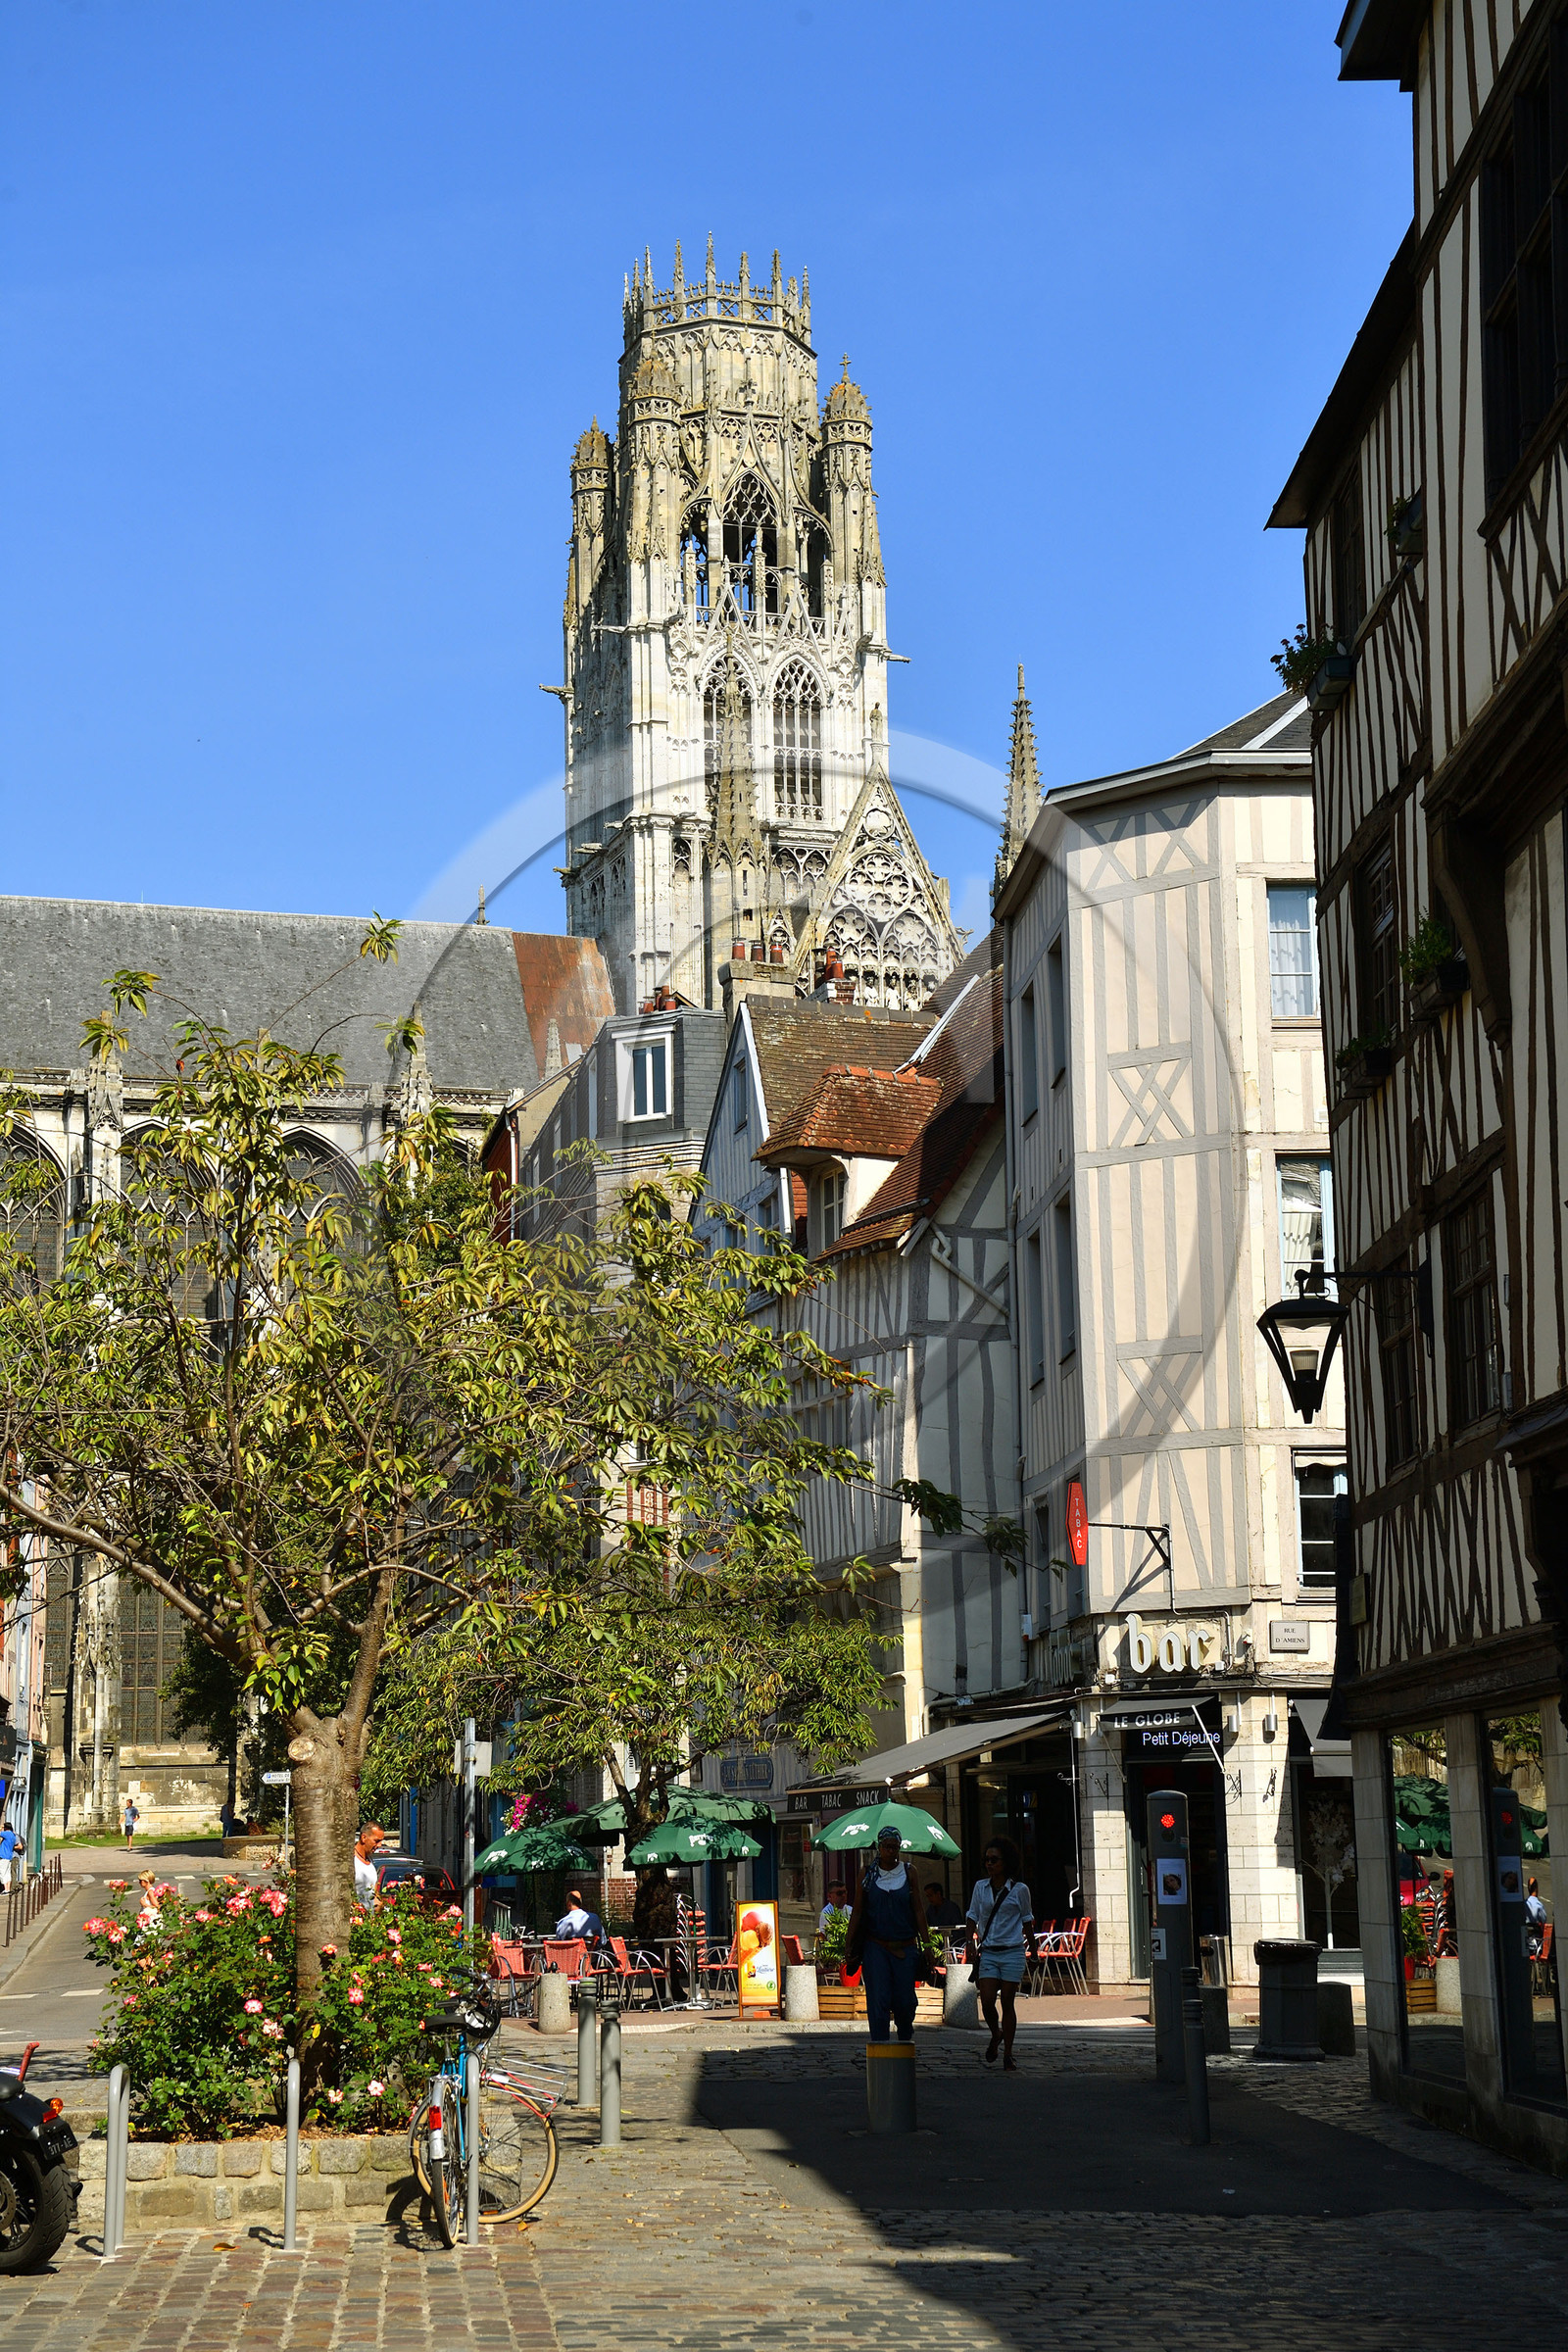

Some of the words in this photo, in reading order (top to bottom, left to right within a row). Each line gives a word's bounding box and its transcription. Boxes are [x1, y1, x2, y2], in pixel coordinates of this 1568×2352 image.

[1074, 1497, 1083, 1548] TABAC
[1125, 1613, 1213, 1674] bar
[1113, 1716, 1129, 1728] LE
[1134, 1711, 1180, 1726] GLOBE
[1143, 1732, 1169, 1744] Petit
[795, 1796, 808, 1810] BAR
[821, 1792, 842, 1808] TABAC
[856, 1789, 880, 1806] SNACK
[48, 2137, 74, 2155] 377-AE
